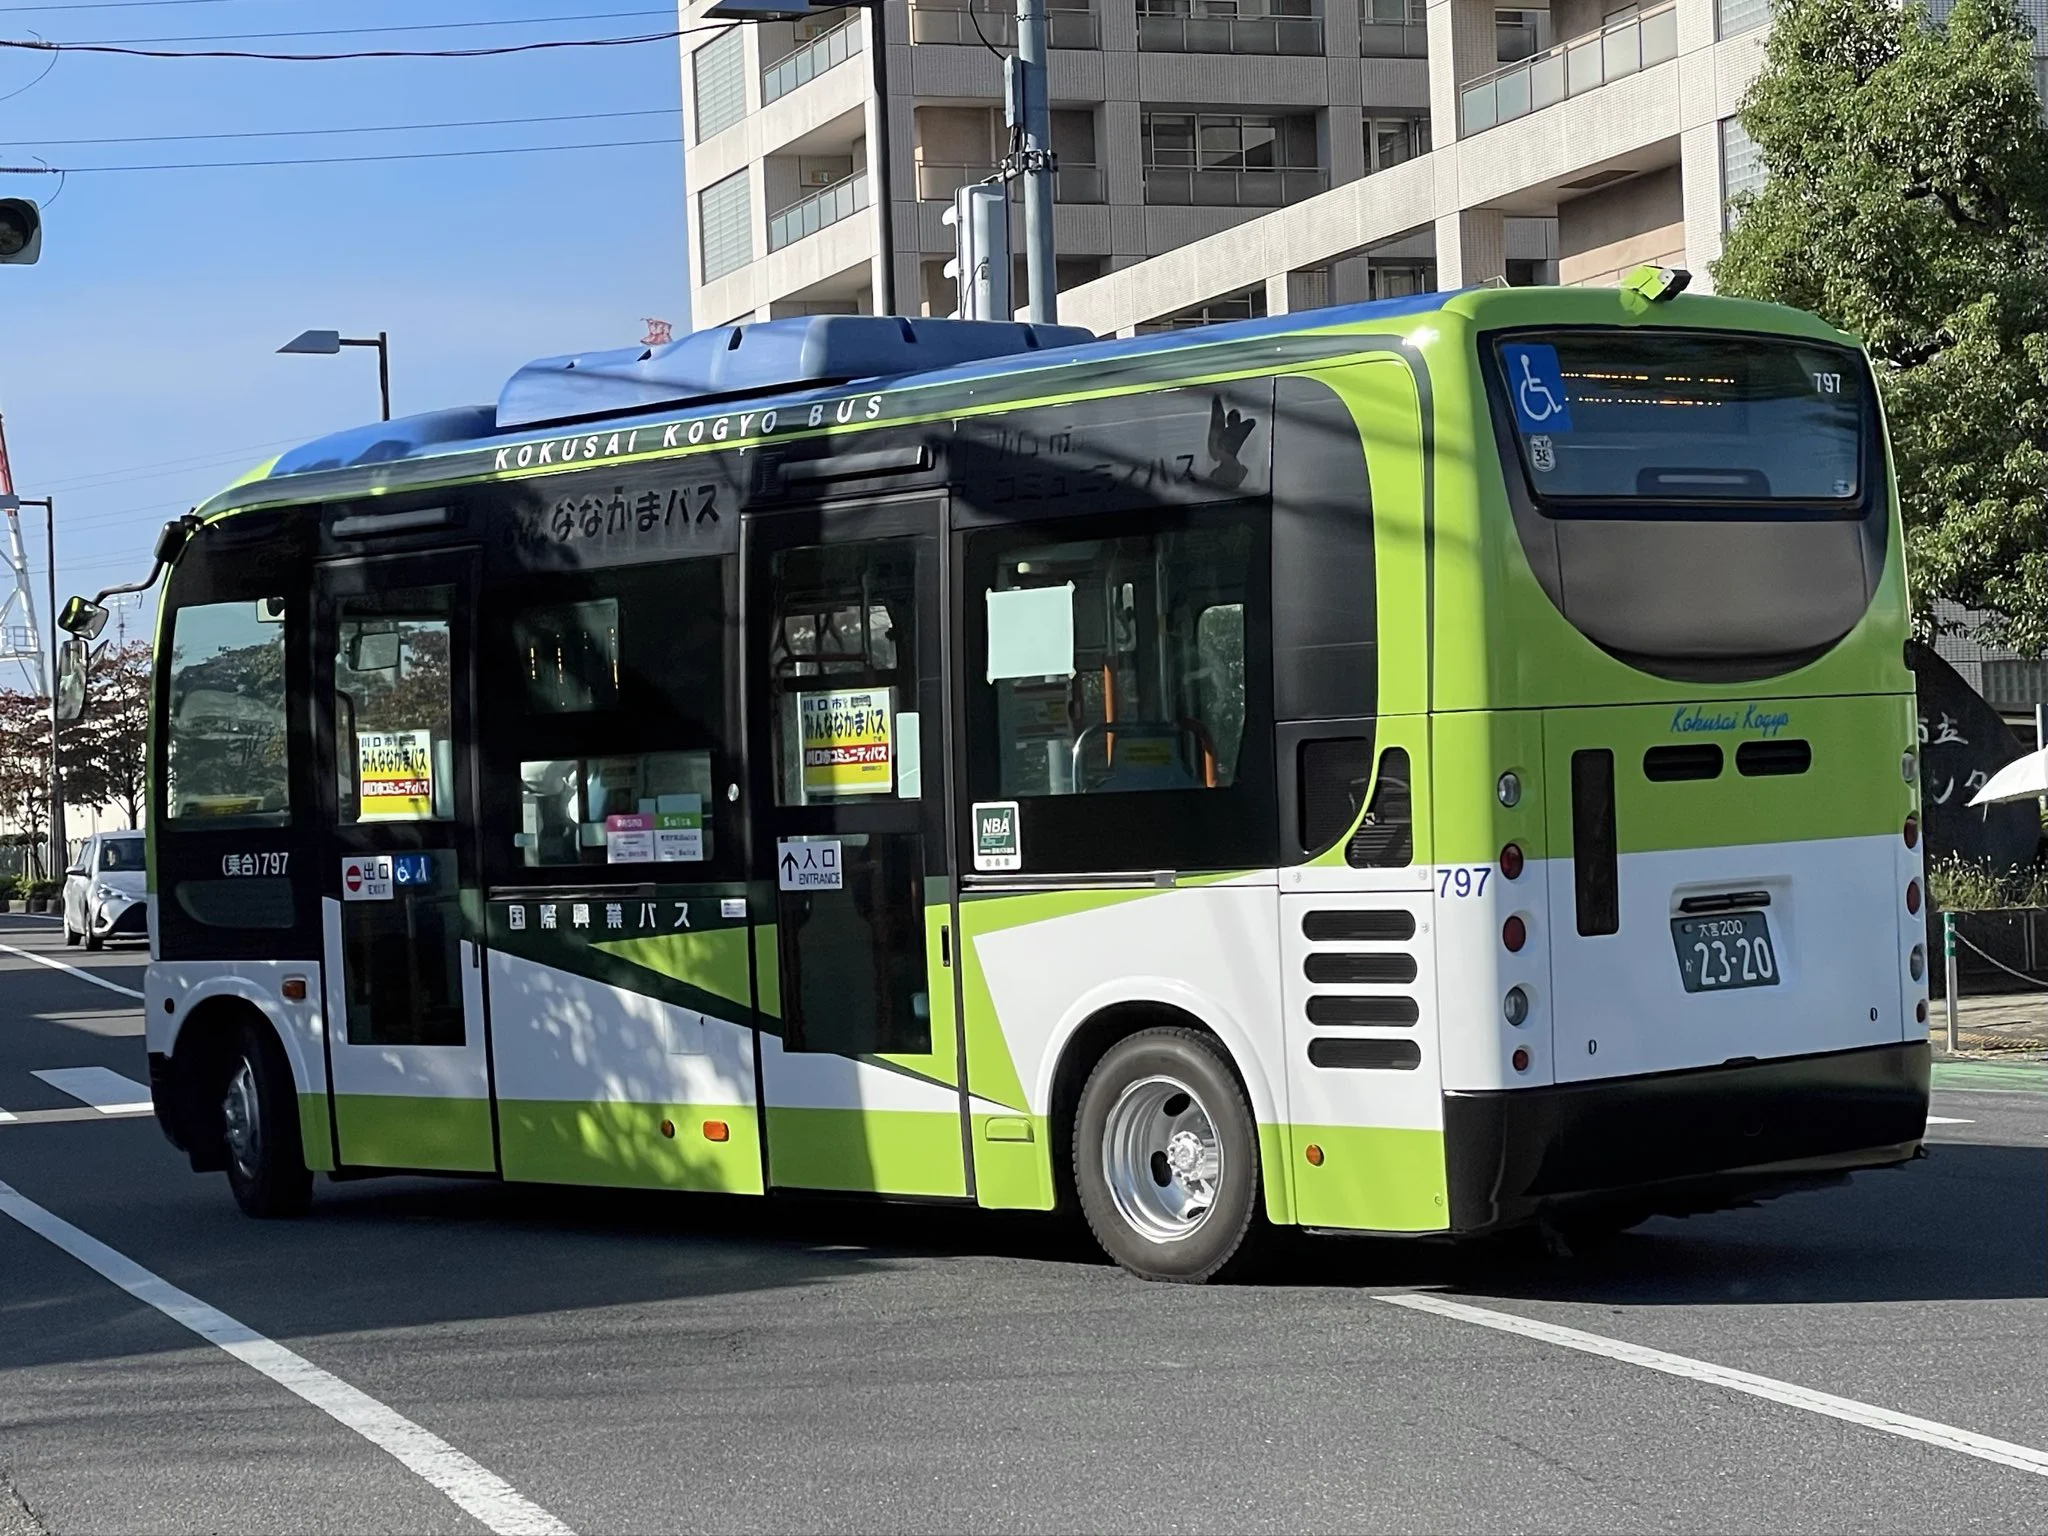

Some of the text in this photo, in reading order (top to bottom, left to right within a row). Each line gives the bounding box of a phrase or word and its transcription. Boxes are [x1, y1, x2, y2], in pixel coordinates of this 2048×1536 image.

[1814, 372, 1841, 394] 797
[494, 395, 882, 471] KOKUSAI KOGYO BUS
[803, 698, 843, 712] 川口市
[804, 709, 886, 739] みんななかまバス
[1670, 704, 1789, 737] Kokusai Kogyo
[361, 737, 393, 748] 川口市
[362, 748, 427, 773] みんななかまバス
[806, 746, 887, 765] 川口市コミュニティバス
[663, 816, 692, 827] Suica
[982, 818, 1010, 834] NBA
[222, 852, 289, 876] (乗合)797
[803, 848, 835, 869] 入口
[363, 863, 389, 880] 出口
[799, 872, 841, 885] ENTRANCE
[368, 884, 386, 895] EXIT
[1437, 868, 1491, 898] 797
[508, 902, 690, 931] 国際興業バス
